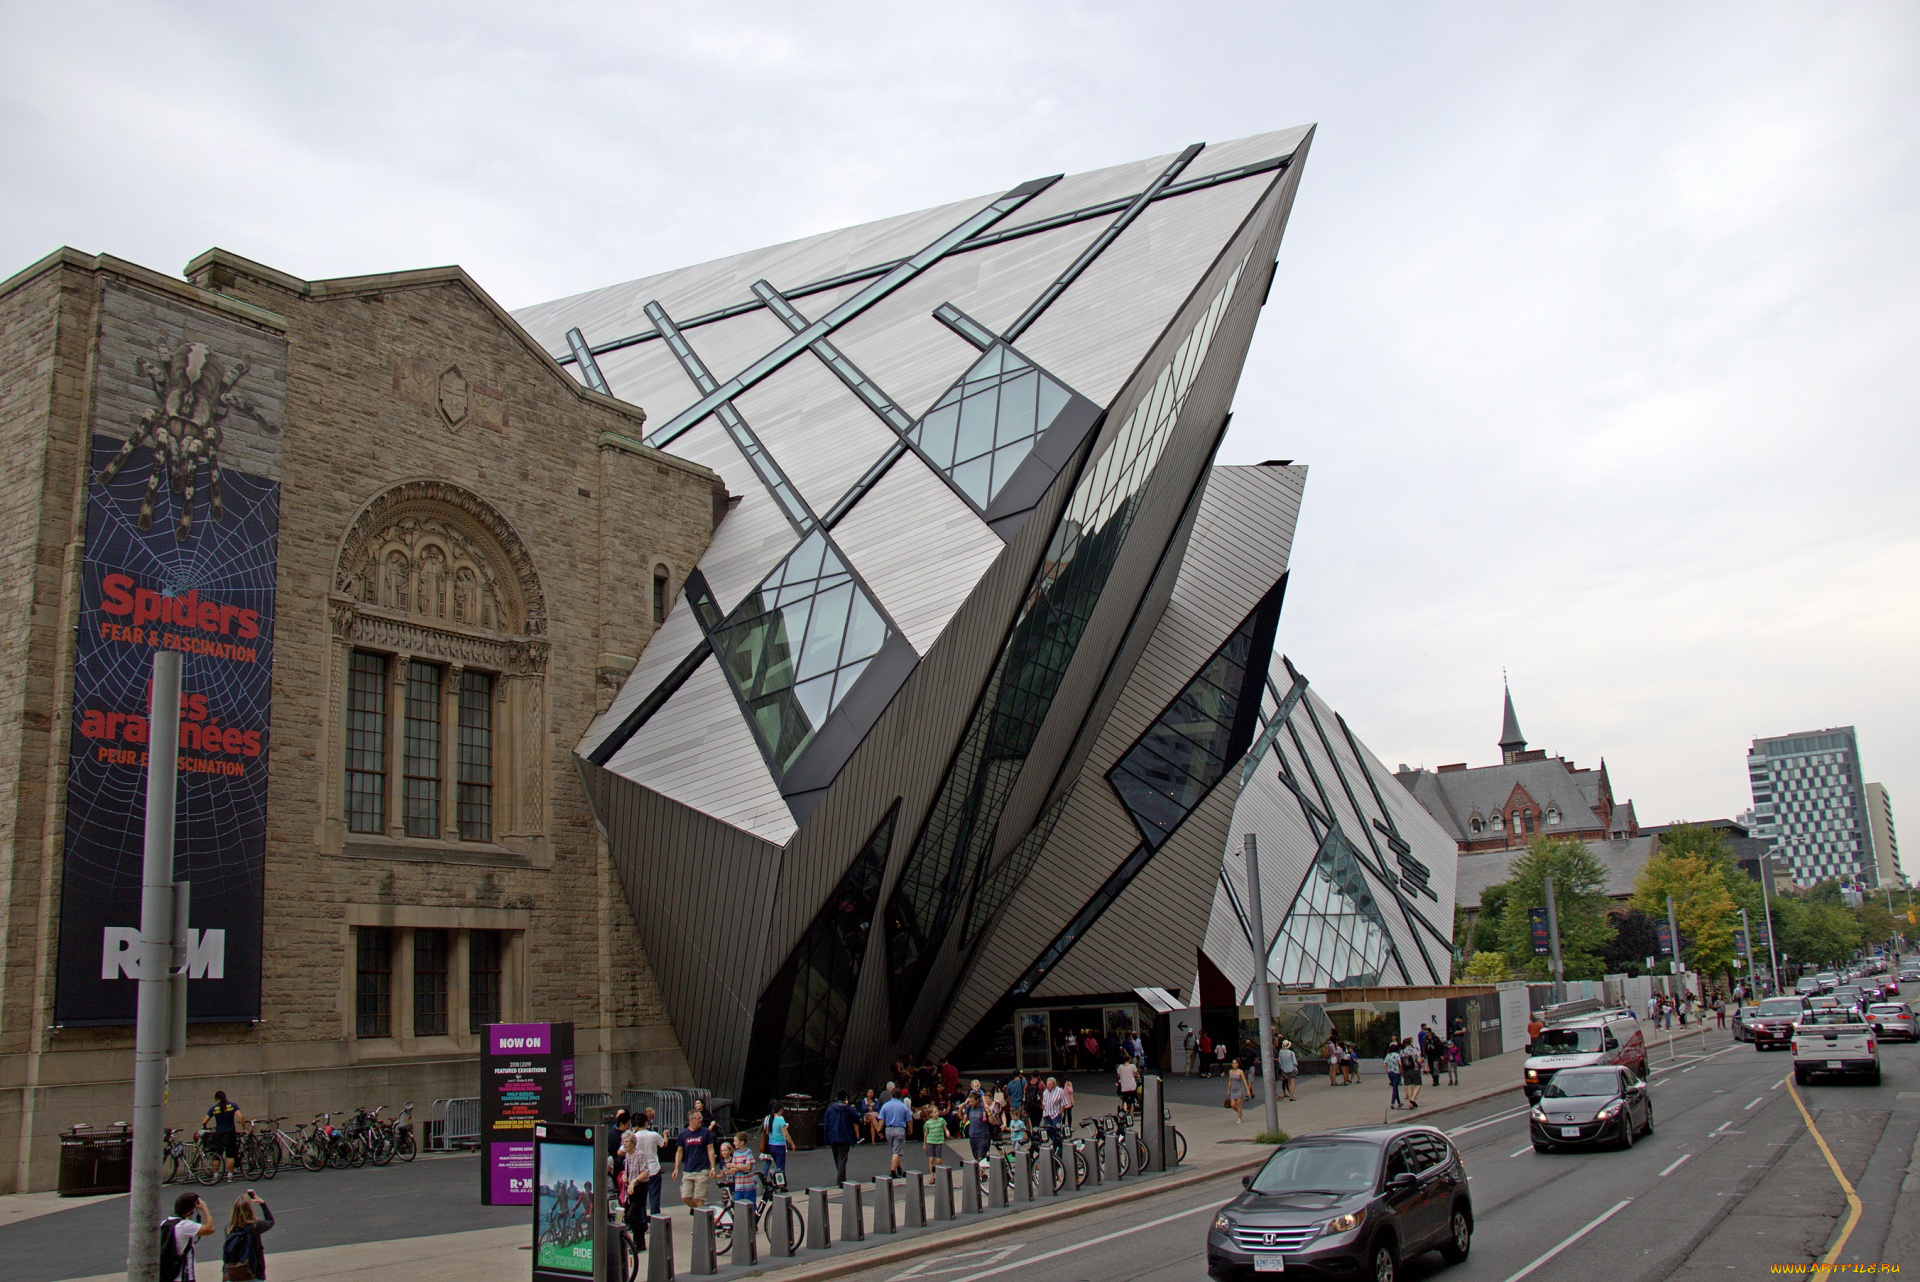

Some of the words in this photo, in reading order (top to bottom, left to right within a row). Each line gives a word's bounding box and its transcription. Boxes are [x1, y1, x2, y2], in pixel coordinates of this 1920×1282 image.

[100, 573, 259, 639] Spiders
[101, 622, 144, 644] FEAR
[148, 632, 160, 647] &
[163, 633, 257, 663] FASCINATION
[80, 709, 262, 757] aranées
[98, 748, 137, 765] PEUR
[177, 756, 244, 777] SCINATION
[102, 926, 226, 980] RM
[499, 1038, 524, 1048] NOW
[526, 1037, 541, 1048] ON
[555, 1256, 592, 1269] TORONTO
[573, 1247, 592, 1258] RIDE
